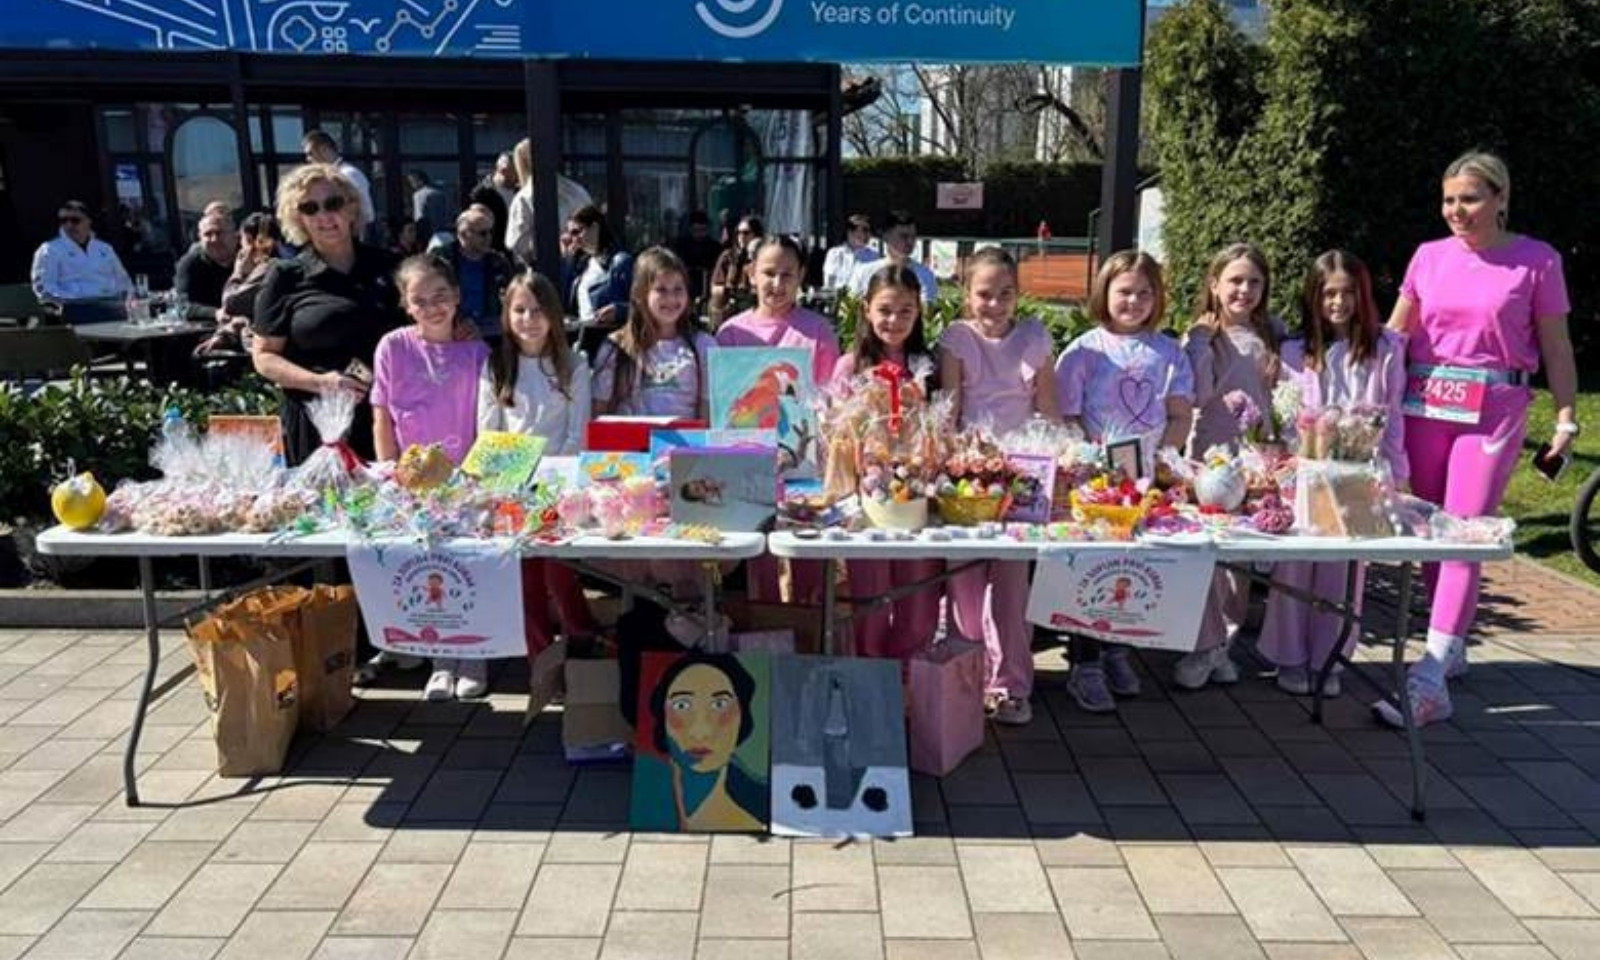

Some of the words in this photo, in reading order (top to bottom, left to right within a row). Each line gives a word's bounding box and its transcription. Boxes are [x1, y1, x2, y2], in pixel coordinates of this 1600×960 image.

[811, 2, 870, 23] Years
[877, 1, 900, 24] of
[904, 3, 1015, 30] Continuity
